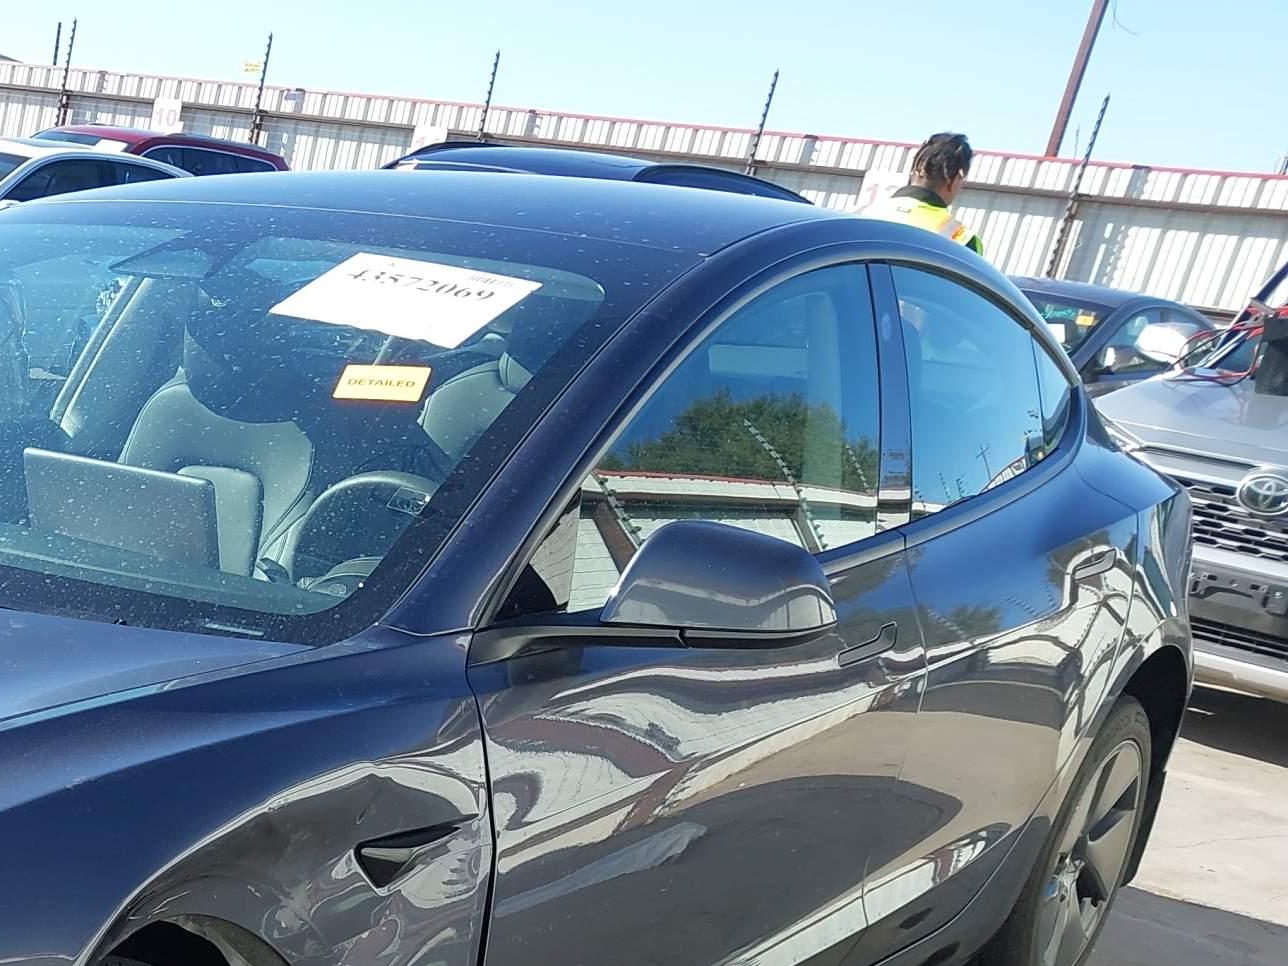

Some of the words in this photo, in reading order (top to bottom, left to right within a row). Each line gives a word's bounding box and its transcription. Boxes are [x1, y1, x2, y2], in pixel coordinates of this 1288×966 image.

[156, 108, 178, 127] 10
[347, 269, 495, 301] 43572069
[347, 377, 416, 388] DETAILED
